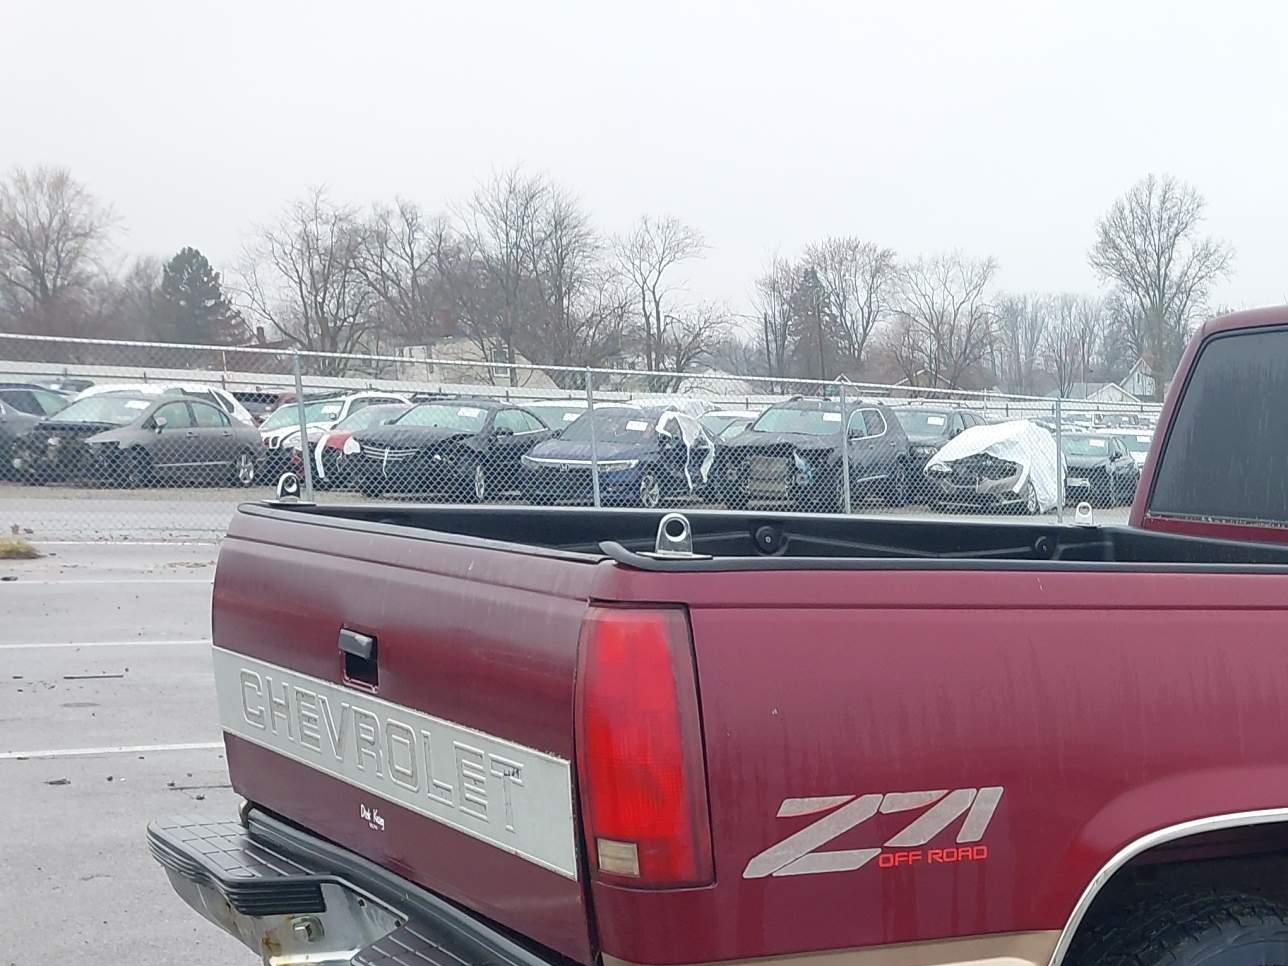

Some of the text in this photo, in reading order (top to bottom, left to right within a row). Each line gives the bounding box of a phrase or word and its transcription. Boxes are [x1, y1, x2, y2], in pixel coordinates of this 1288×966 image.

[239, 667, 525, 833] CHEVROLET
[742, 785, 1004, 879] Z71
[879, 845, 988, 868] OFF ROAD
